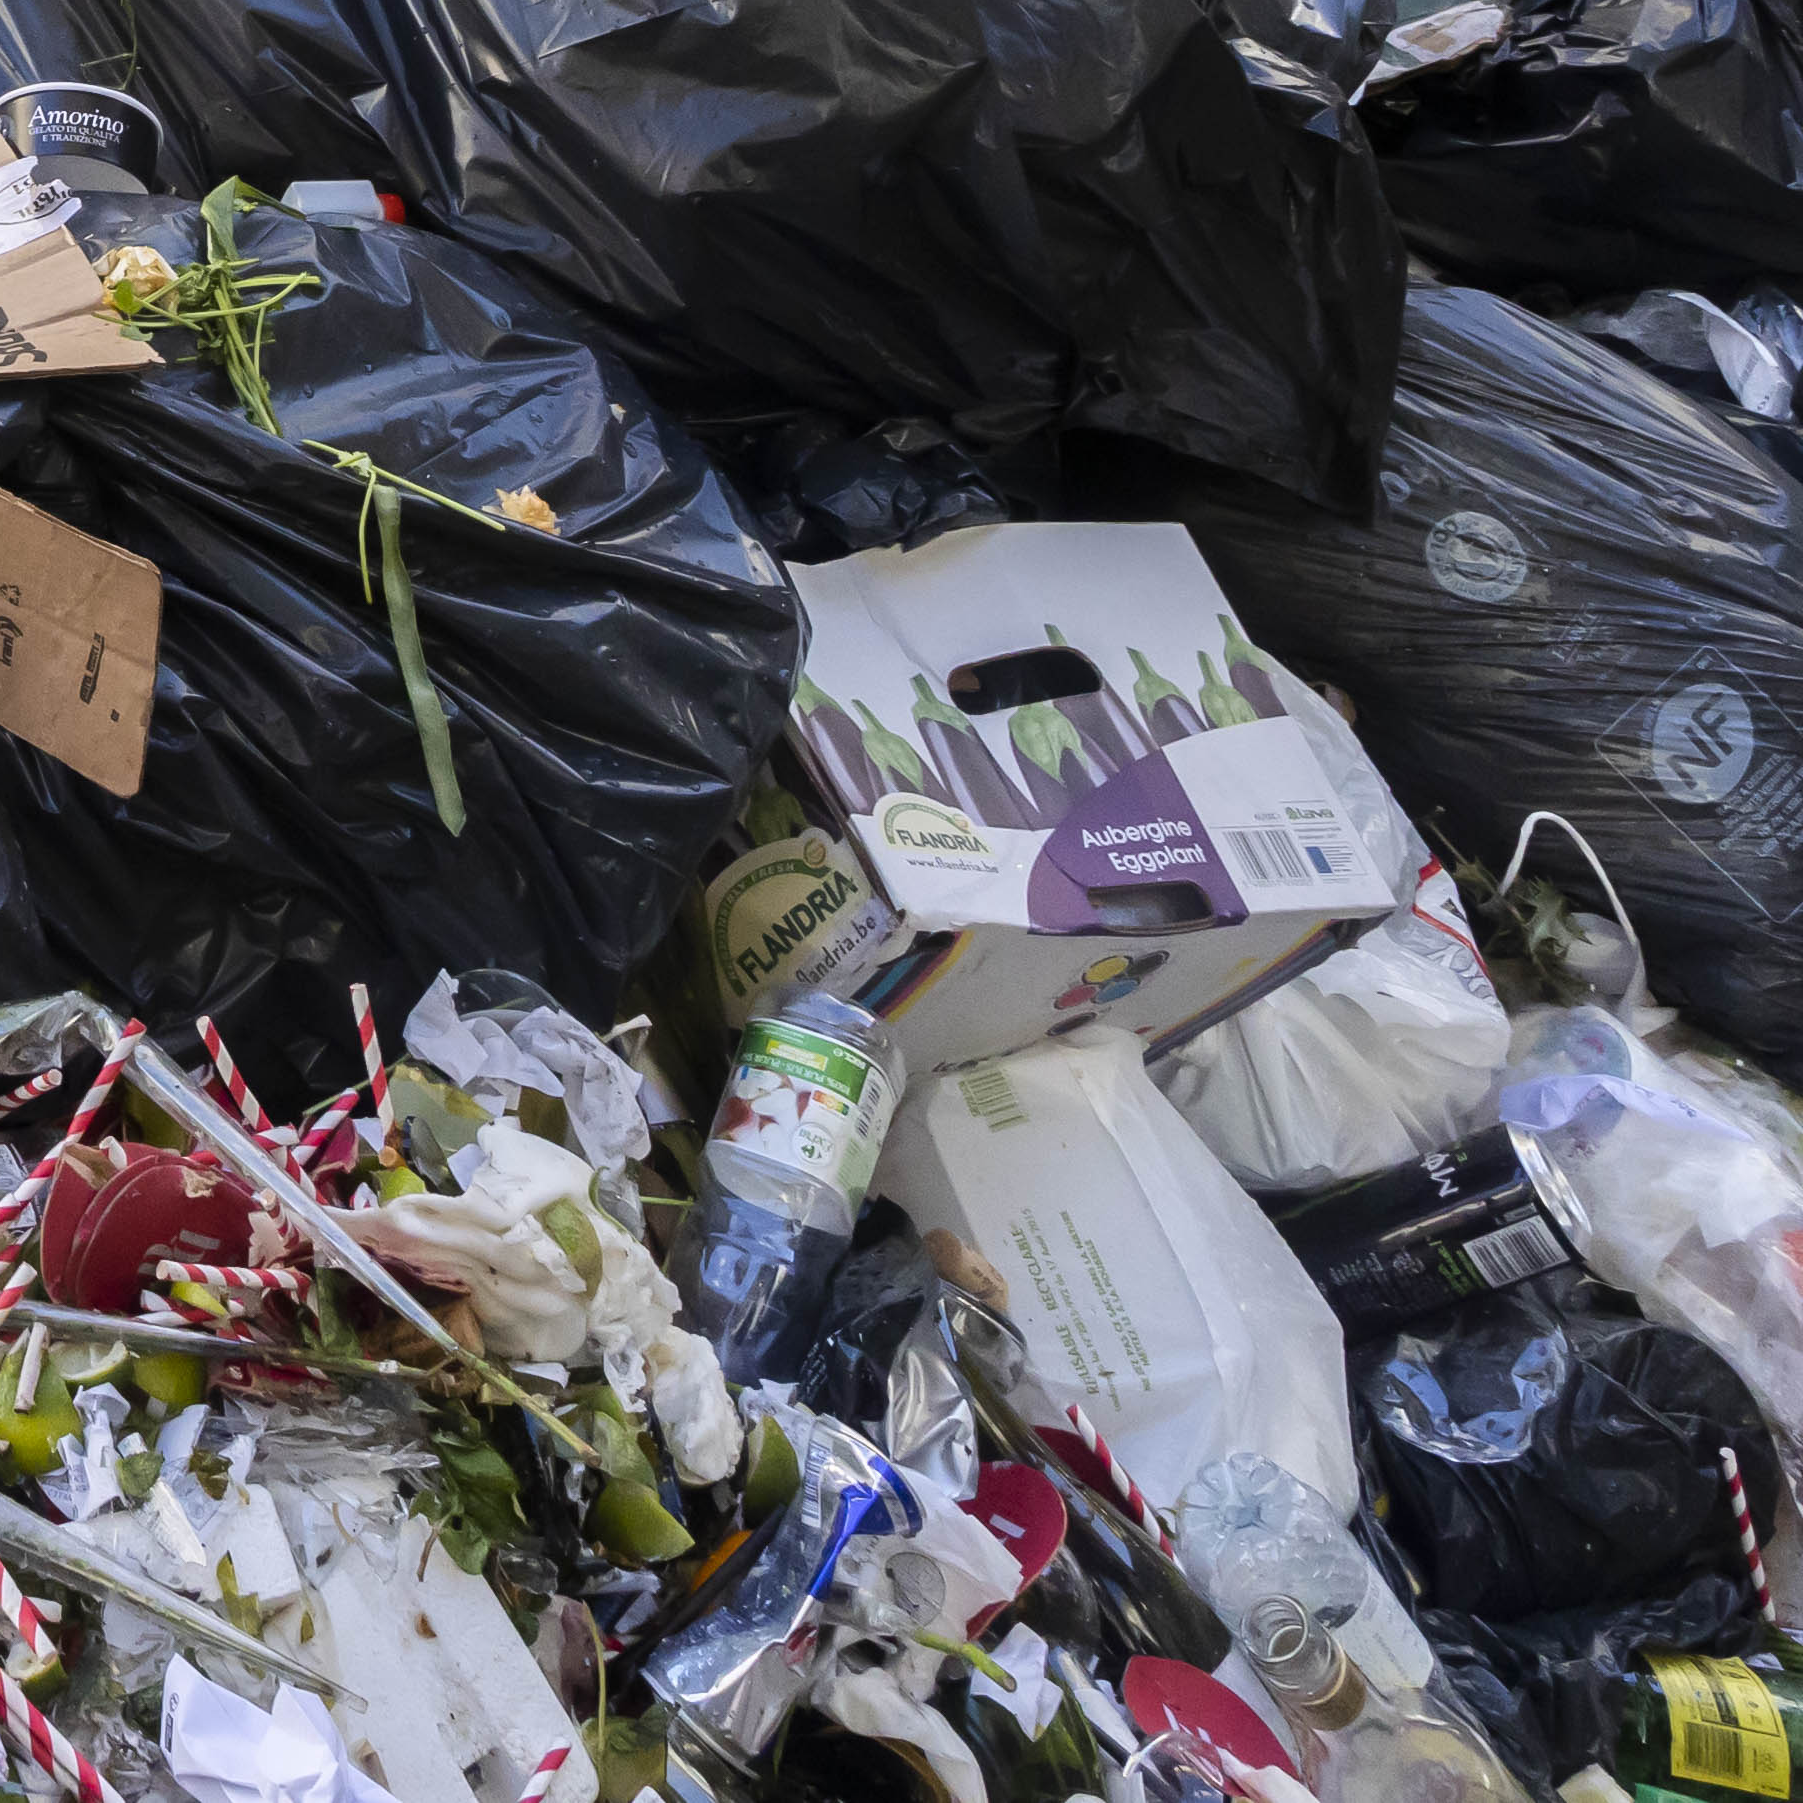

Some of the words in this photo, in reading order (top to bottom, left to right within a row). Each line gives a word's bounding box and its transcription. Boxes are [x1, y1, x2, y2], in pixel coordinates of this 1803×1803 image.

[27, 105, 125, 135] Amorino
[28, 124, 66, 136] GELATO
[66, 125, 78, 134] DI
[50, 134, 108, 149] TRADIZIONE
[1666, 692, 1735, 792] NF
[896, 829, 990, 854] FLANDRIA
[1081, 817, 1193, 849] Aubergine
[907, 856, 1000, 875] www.flandria.be
[1108, 843, 1207, 875] Eggplant
[736, 869, 859, 985] FLANDRIA
[1010, 1226, 1060, 1313] RECYCLABLE
